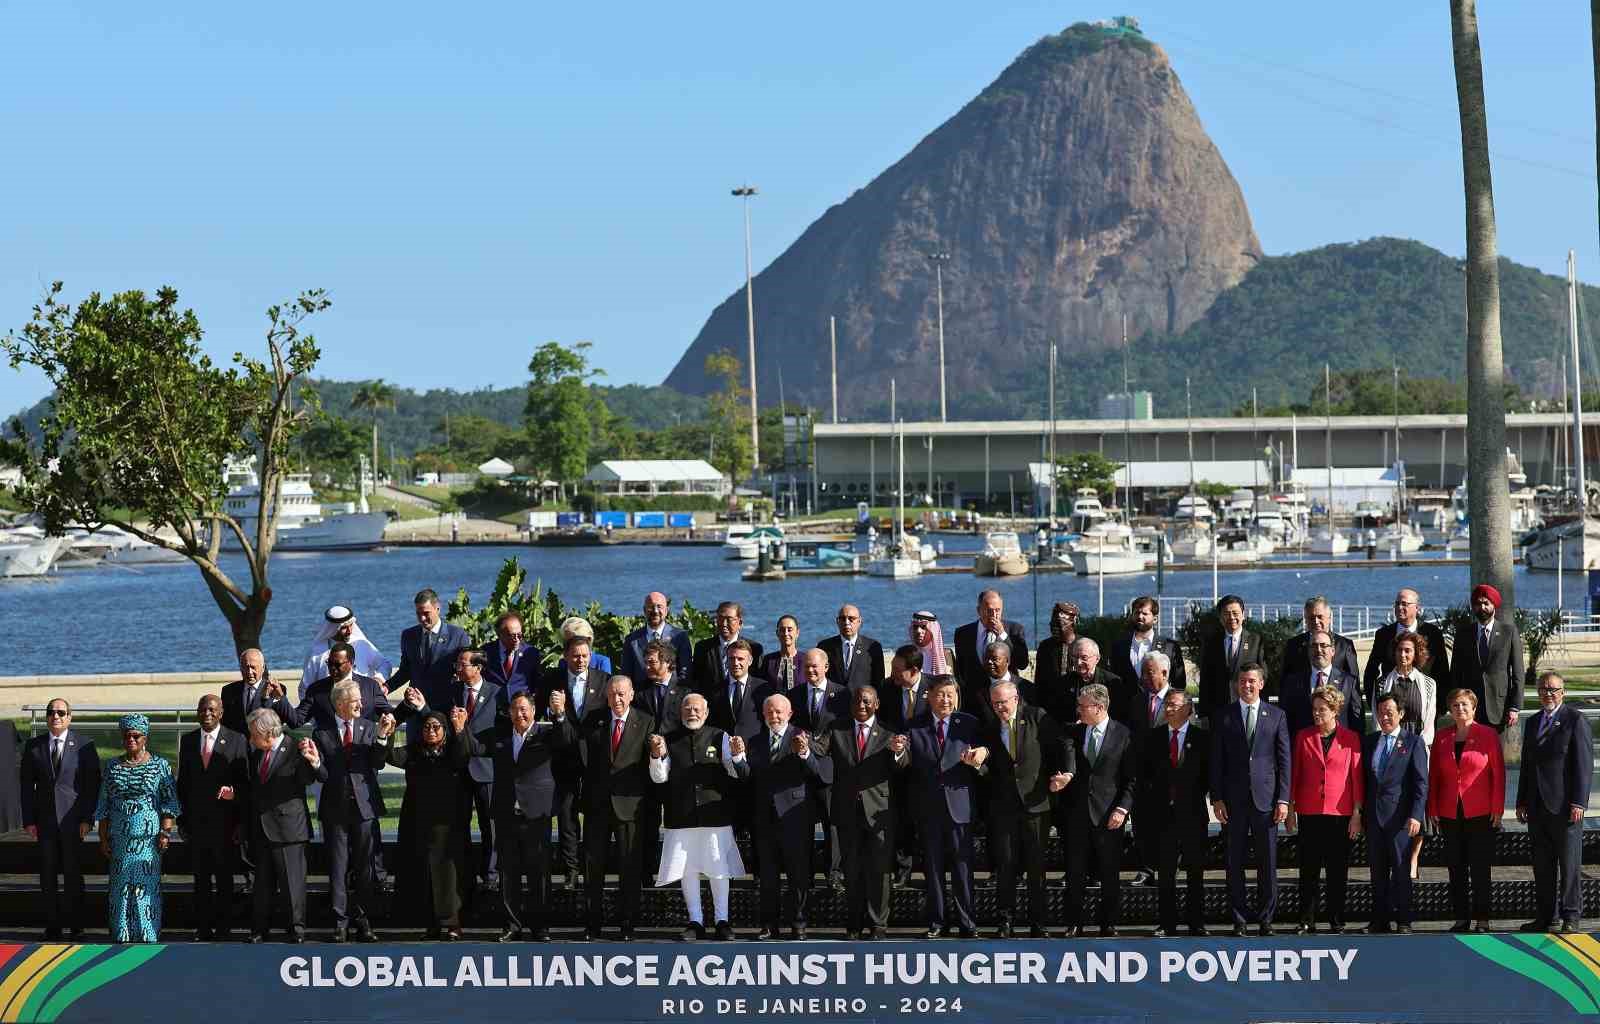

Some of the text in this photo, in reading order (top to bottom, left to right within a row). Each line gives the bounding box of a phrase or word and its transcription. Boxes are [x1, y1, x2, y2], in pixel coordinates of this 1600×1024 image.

[280, 949, 1358, 988] GLOBAL ALLIANCE AGAINST HUNGER AND POVERTY
[662, 999, 704, 1014] RIO
[717, 999, 747, 1014] DE
[758, 999, 867, 1014] JANEIRO
[900, 998, 963, 1013] 2024
